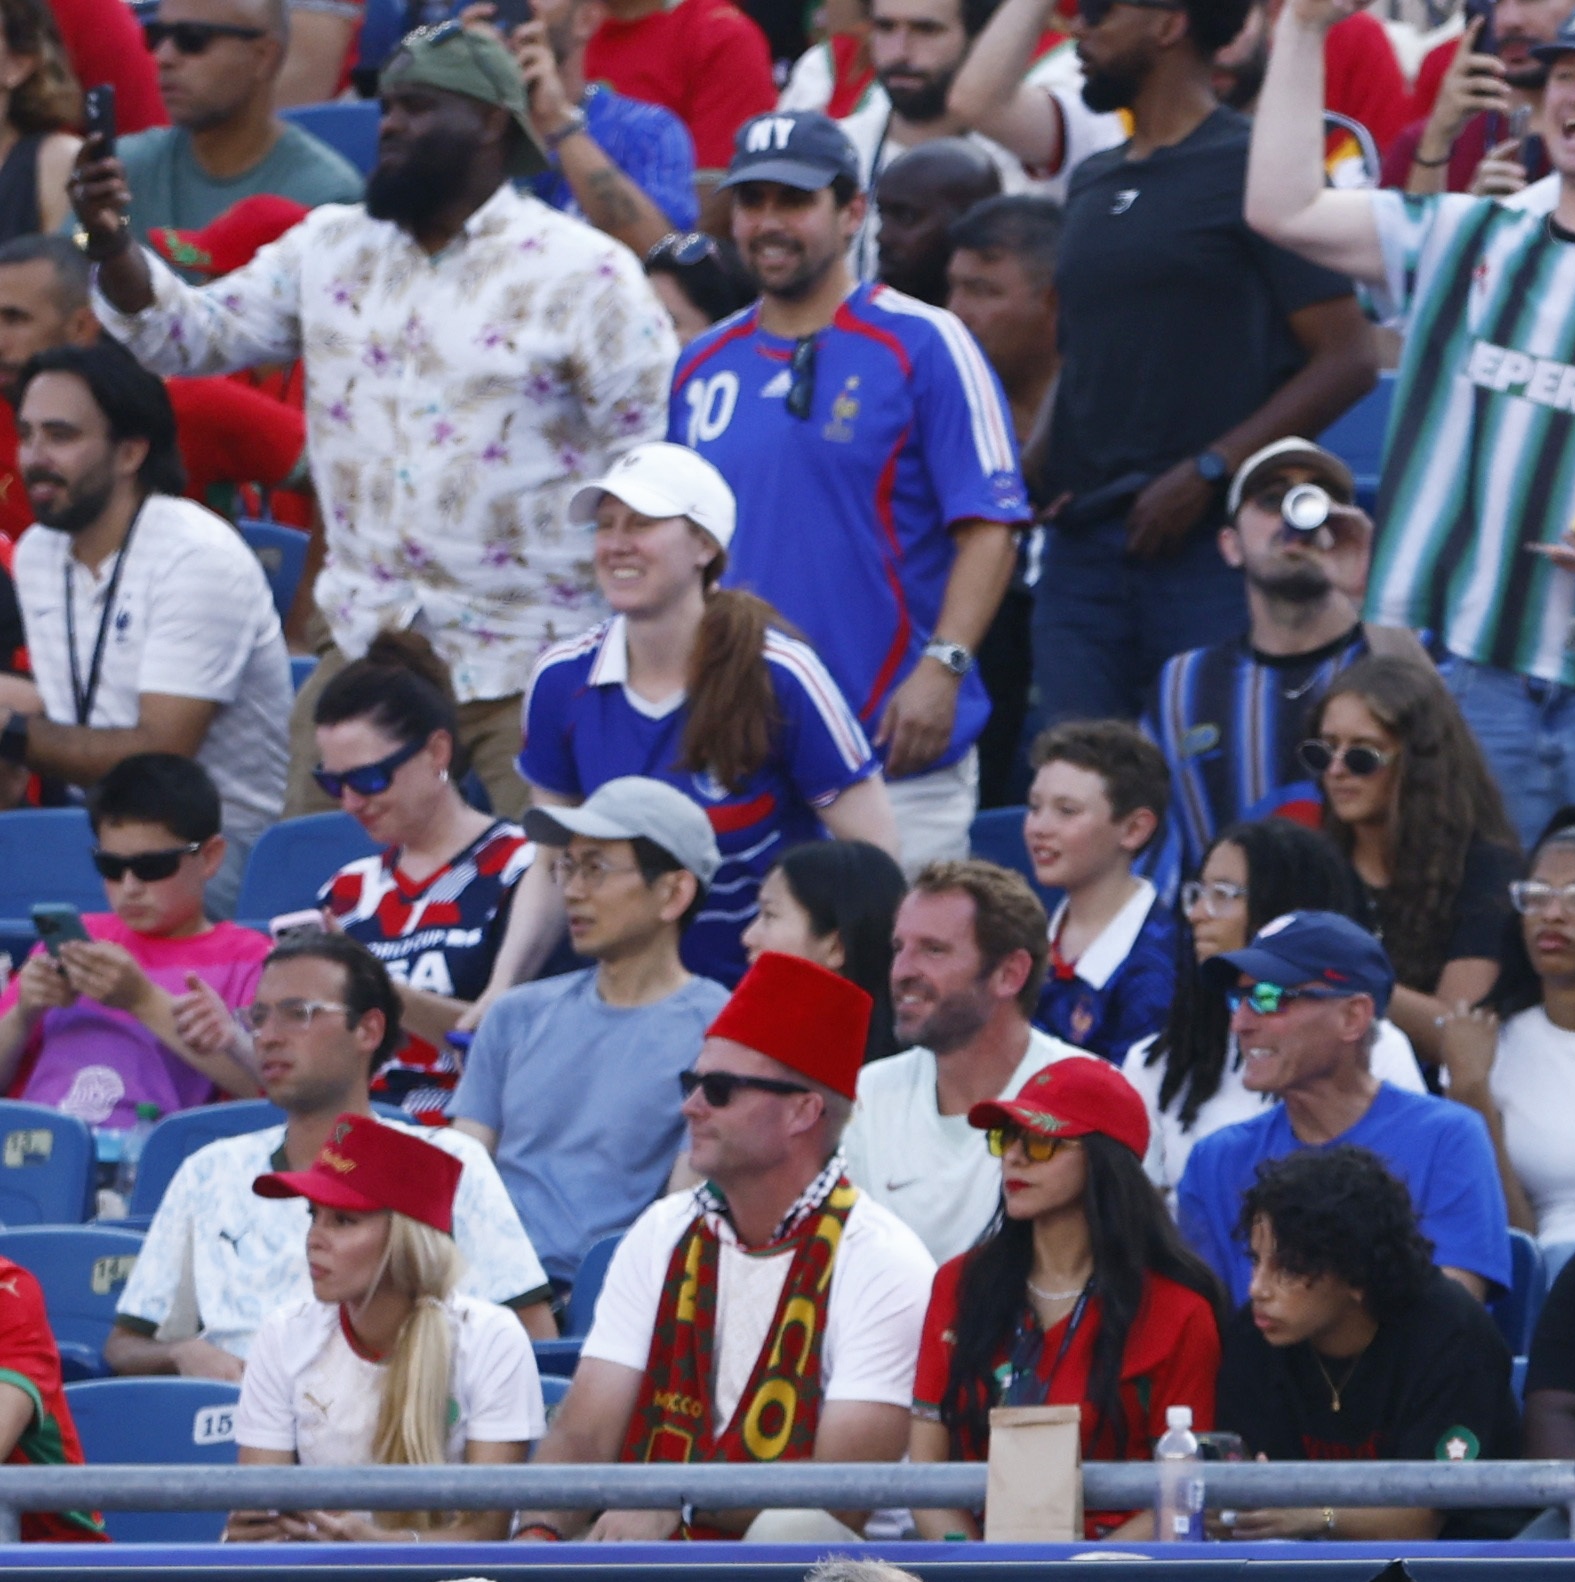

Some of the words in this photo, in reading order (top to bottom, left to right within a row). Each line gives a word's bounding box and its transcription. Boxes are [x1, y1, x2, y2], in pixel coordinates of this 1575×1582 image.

[746, 117, 797, 153] NY
[685, 371, 740, 450] 10
[203, 1413, 233, 1438] 15
